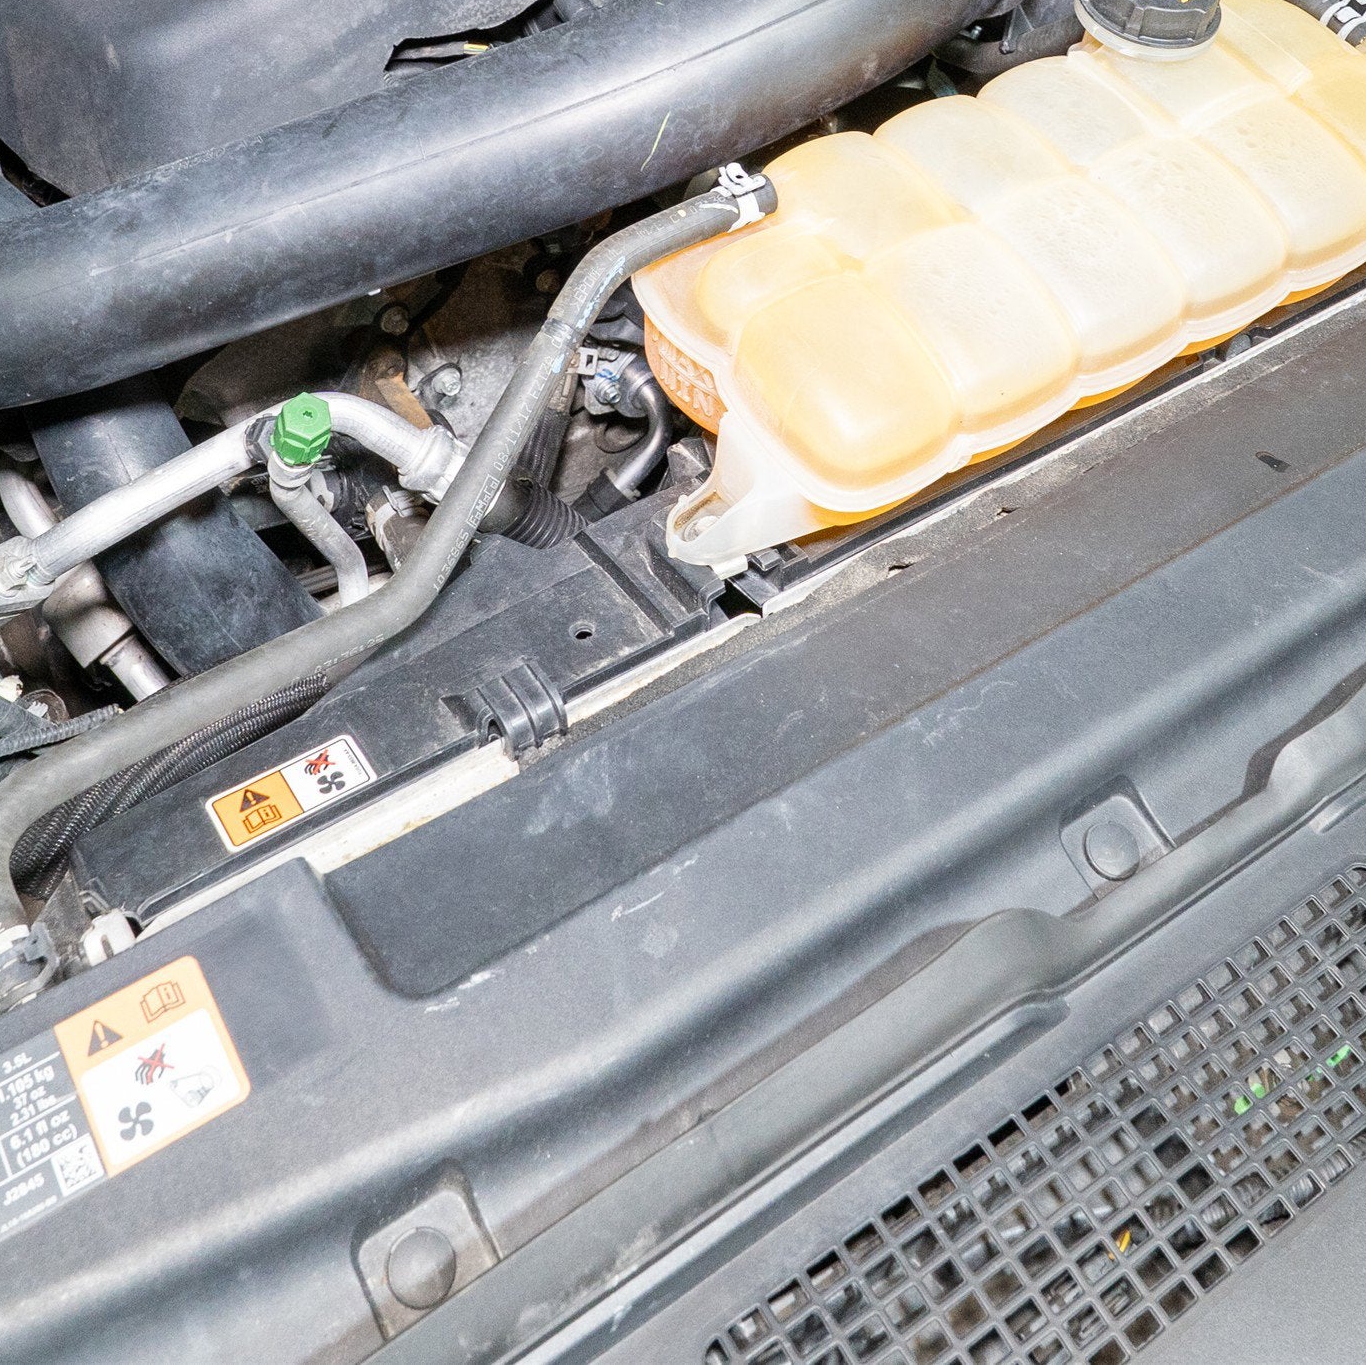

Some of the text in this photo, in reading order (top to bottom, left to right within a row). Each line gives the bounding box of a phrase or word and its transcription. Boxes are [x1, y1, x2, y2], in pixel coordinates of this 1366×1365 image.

[661, 366, 715, 416] MIN
[469, 476, 497, 527] FoMoCo
[495, 404, 532, 471] 08/11/17
[2, 1052, 31, 1073] 3.5L
[33, 1065, 54, 1082] kg
[12, 1085, 46, 1109] 37 oz
[10, 1103, 35, 1126] 2.31
[9, 1110, 69, 1149] 6.1 fl oz
[52, 1123, 77, 1145] cc)
